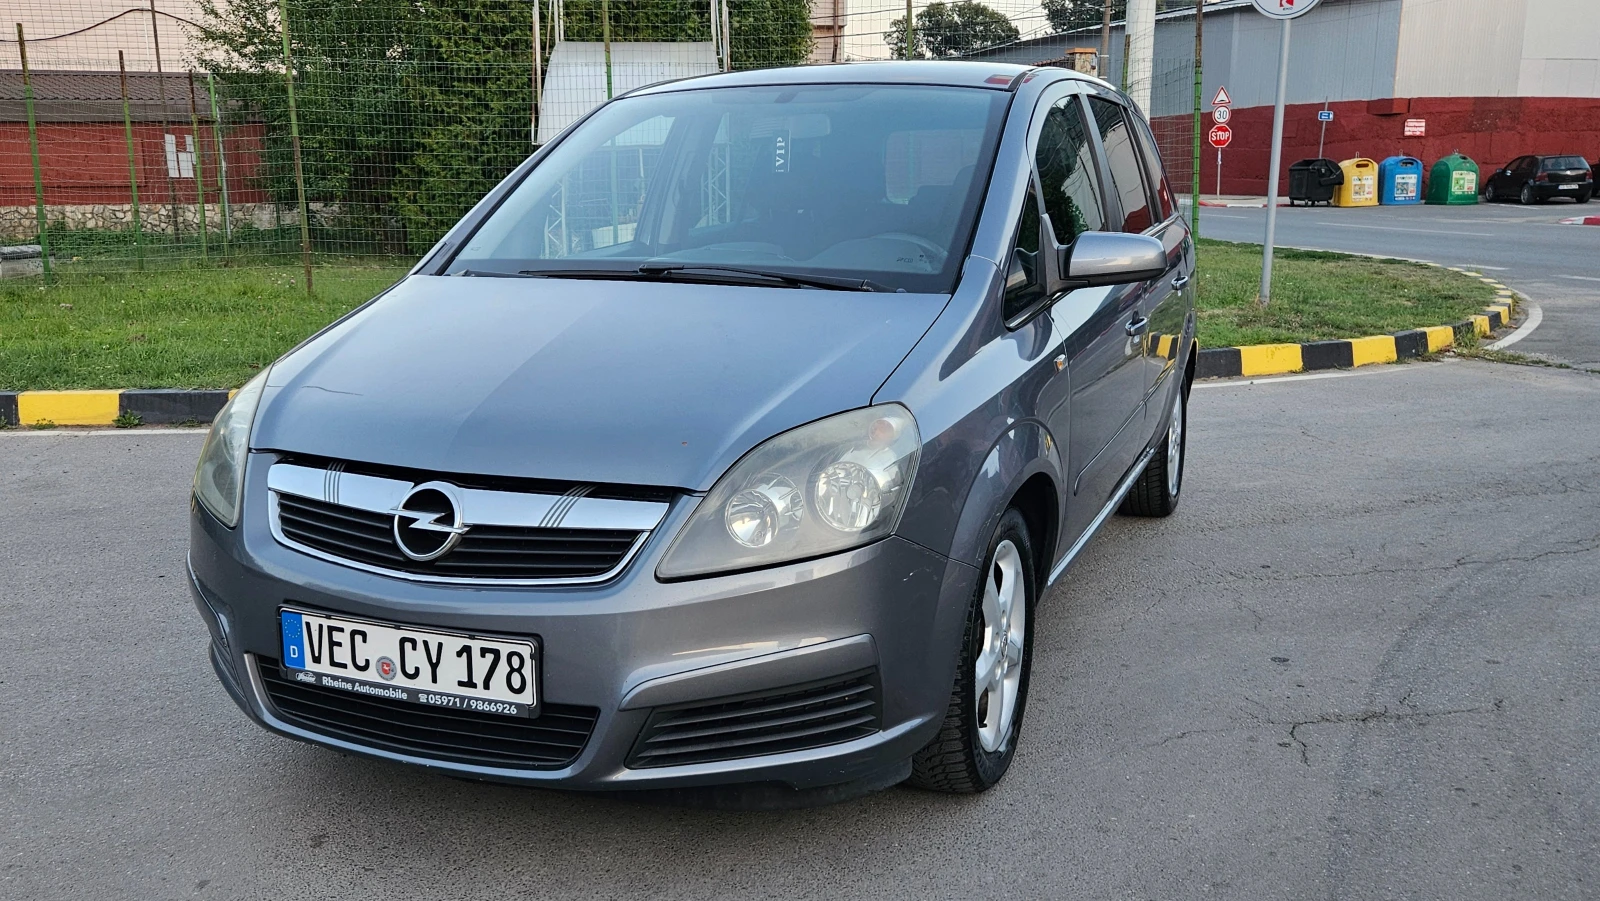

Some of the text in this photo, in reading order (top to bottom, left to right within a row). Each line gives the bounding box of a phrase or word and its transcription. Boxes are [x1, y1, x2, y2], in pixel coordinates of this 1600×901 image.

[1216, 110, 1228, 120] 30
[1211, 131, 1230, 141] STOP
[290, 645, 299, 658] D
[305, 621, 370, 672] VEC
[399, 636, 444, 684] CY
[456, 644, 527, 695] 178
[322, 676, 353, 690] Rheine
[354, 682, 408, 700] Automobile
[428, 694, 460, 707] 05971
[470, 699, 517, 715] 9866926
